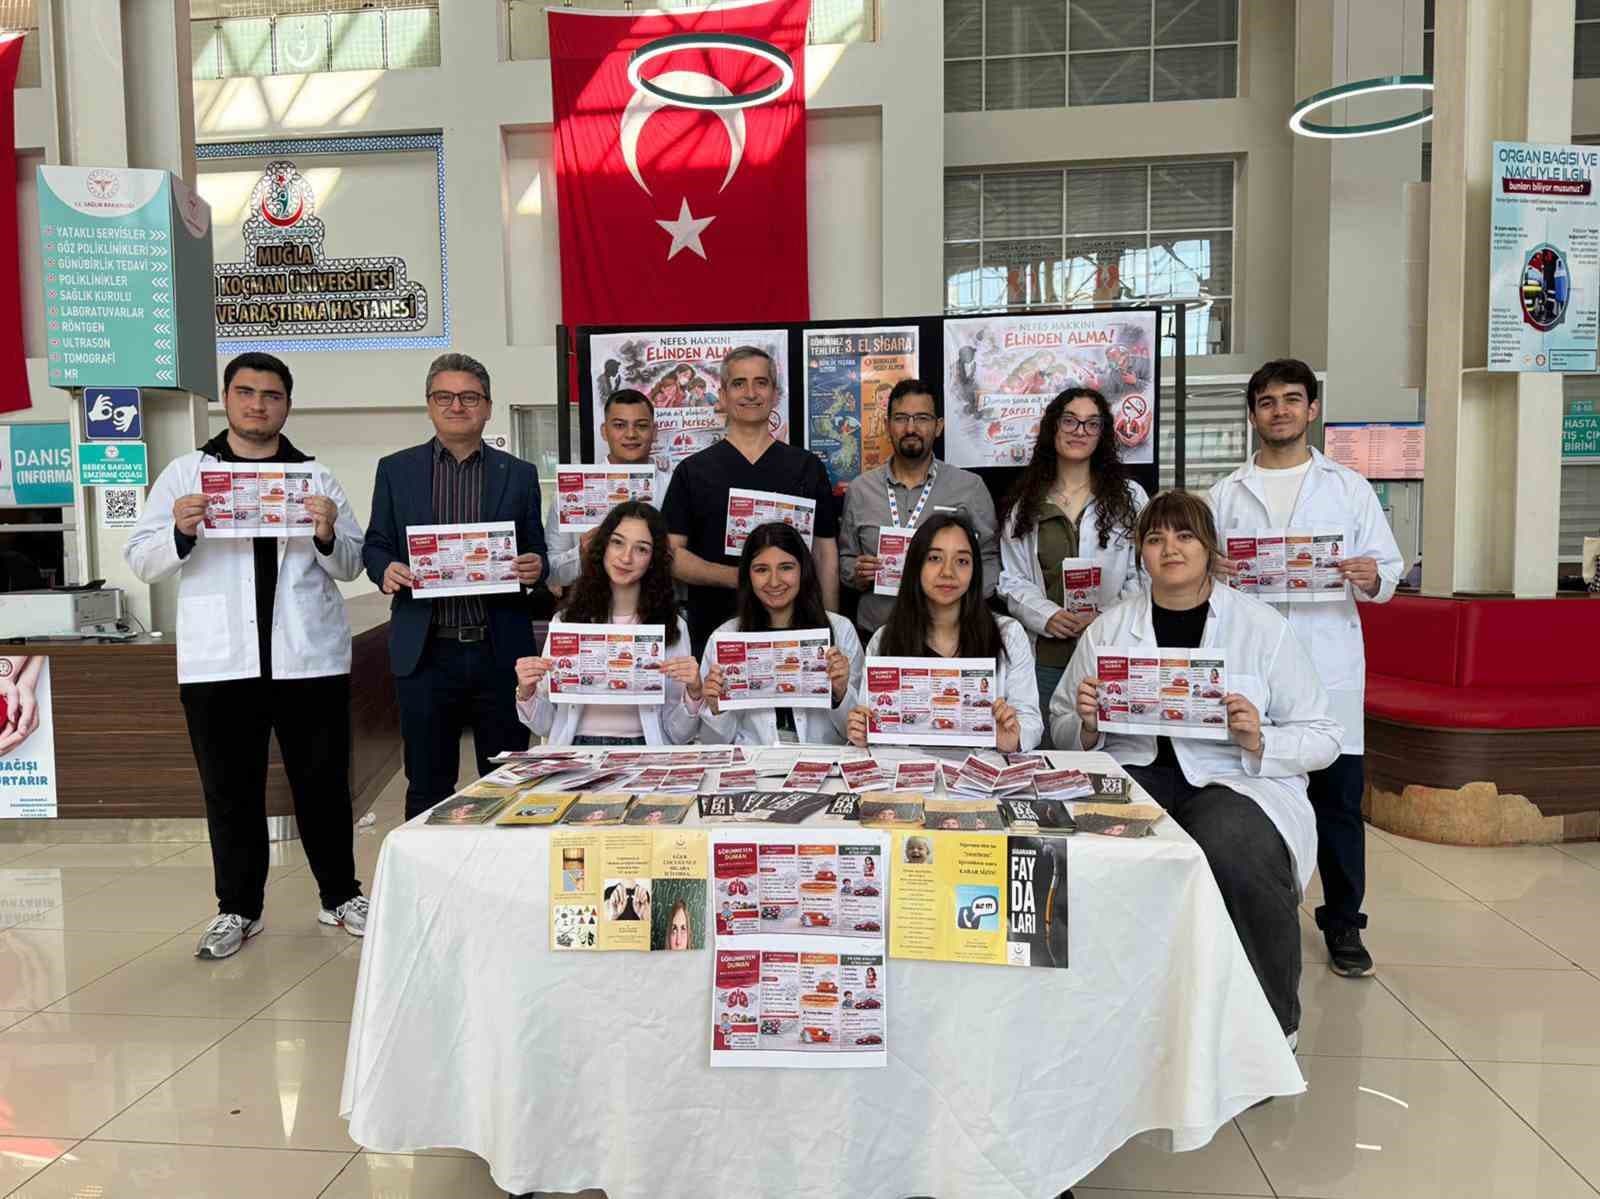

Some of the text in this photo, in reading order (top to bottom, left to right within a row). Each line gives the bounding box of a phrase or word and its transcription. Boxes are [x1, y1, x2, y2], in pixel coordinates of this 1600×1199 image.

[1499, 149, 1540, 163] ORGAN
[1582, 152, 1598, 166] VE
[56, 225, 146, 240] YATAKLI SERVİSLER
[56, 242, 75, 253] GÖZ
[256, 243, 314, 266] MUĞLA
[221, 267, 395, 299] KOÇMAN ÜNİVERSİTESİ
[60, 288, 132, 302] SAĞLIK KURULU
[60, 306, 144, 319] LABORATUVARLAR
[216, 294, 416, 327] VE ARAŞTIRMA HASTANESİ
[61, 320, 105, 333] RÖNTGEN
[62, 337, 111, 349] ULTRASON
[660, 335, 731, 346] NEFES HAKKINI
[845, 335, 912, 353] 3. EL SİGARA
[1004, 329, 1115, 347] ELİNDEN ALMA!
[646, 347, 701, 361] ELİNDEN
[64, 368, 79, 379] MR
[1564, 419, 1598, 429] HASTA
[1564, 440, 1597, 451] BİRİMİ
[14, 448, 71, 468] DANIŞ
[16, 469, 73, 485] (INFORMA
[1011, 856, 1036, 881] FAY
[1011, 880, 1036, 913] DA
[1011, 913, 1037, 934] LARI
